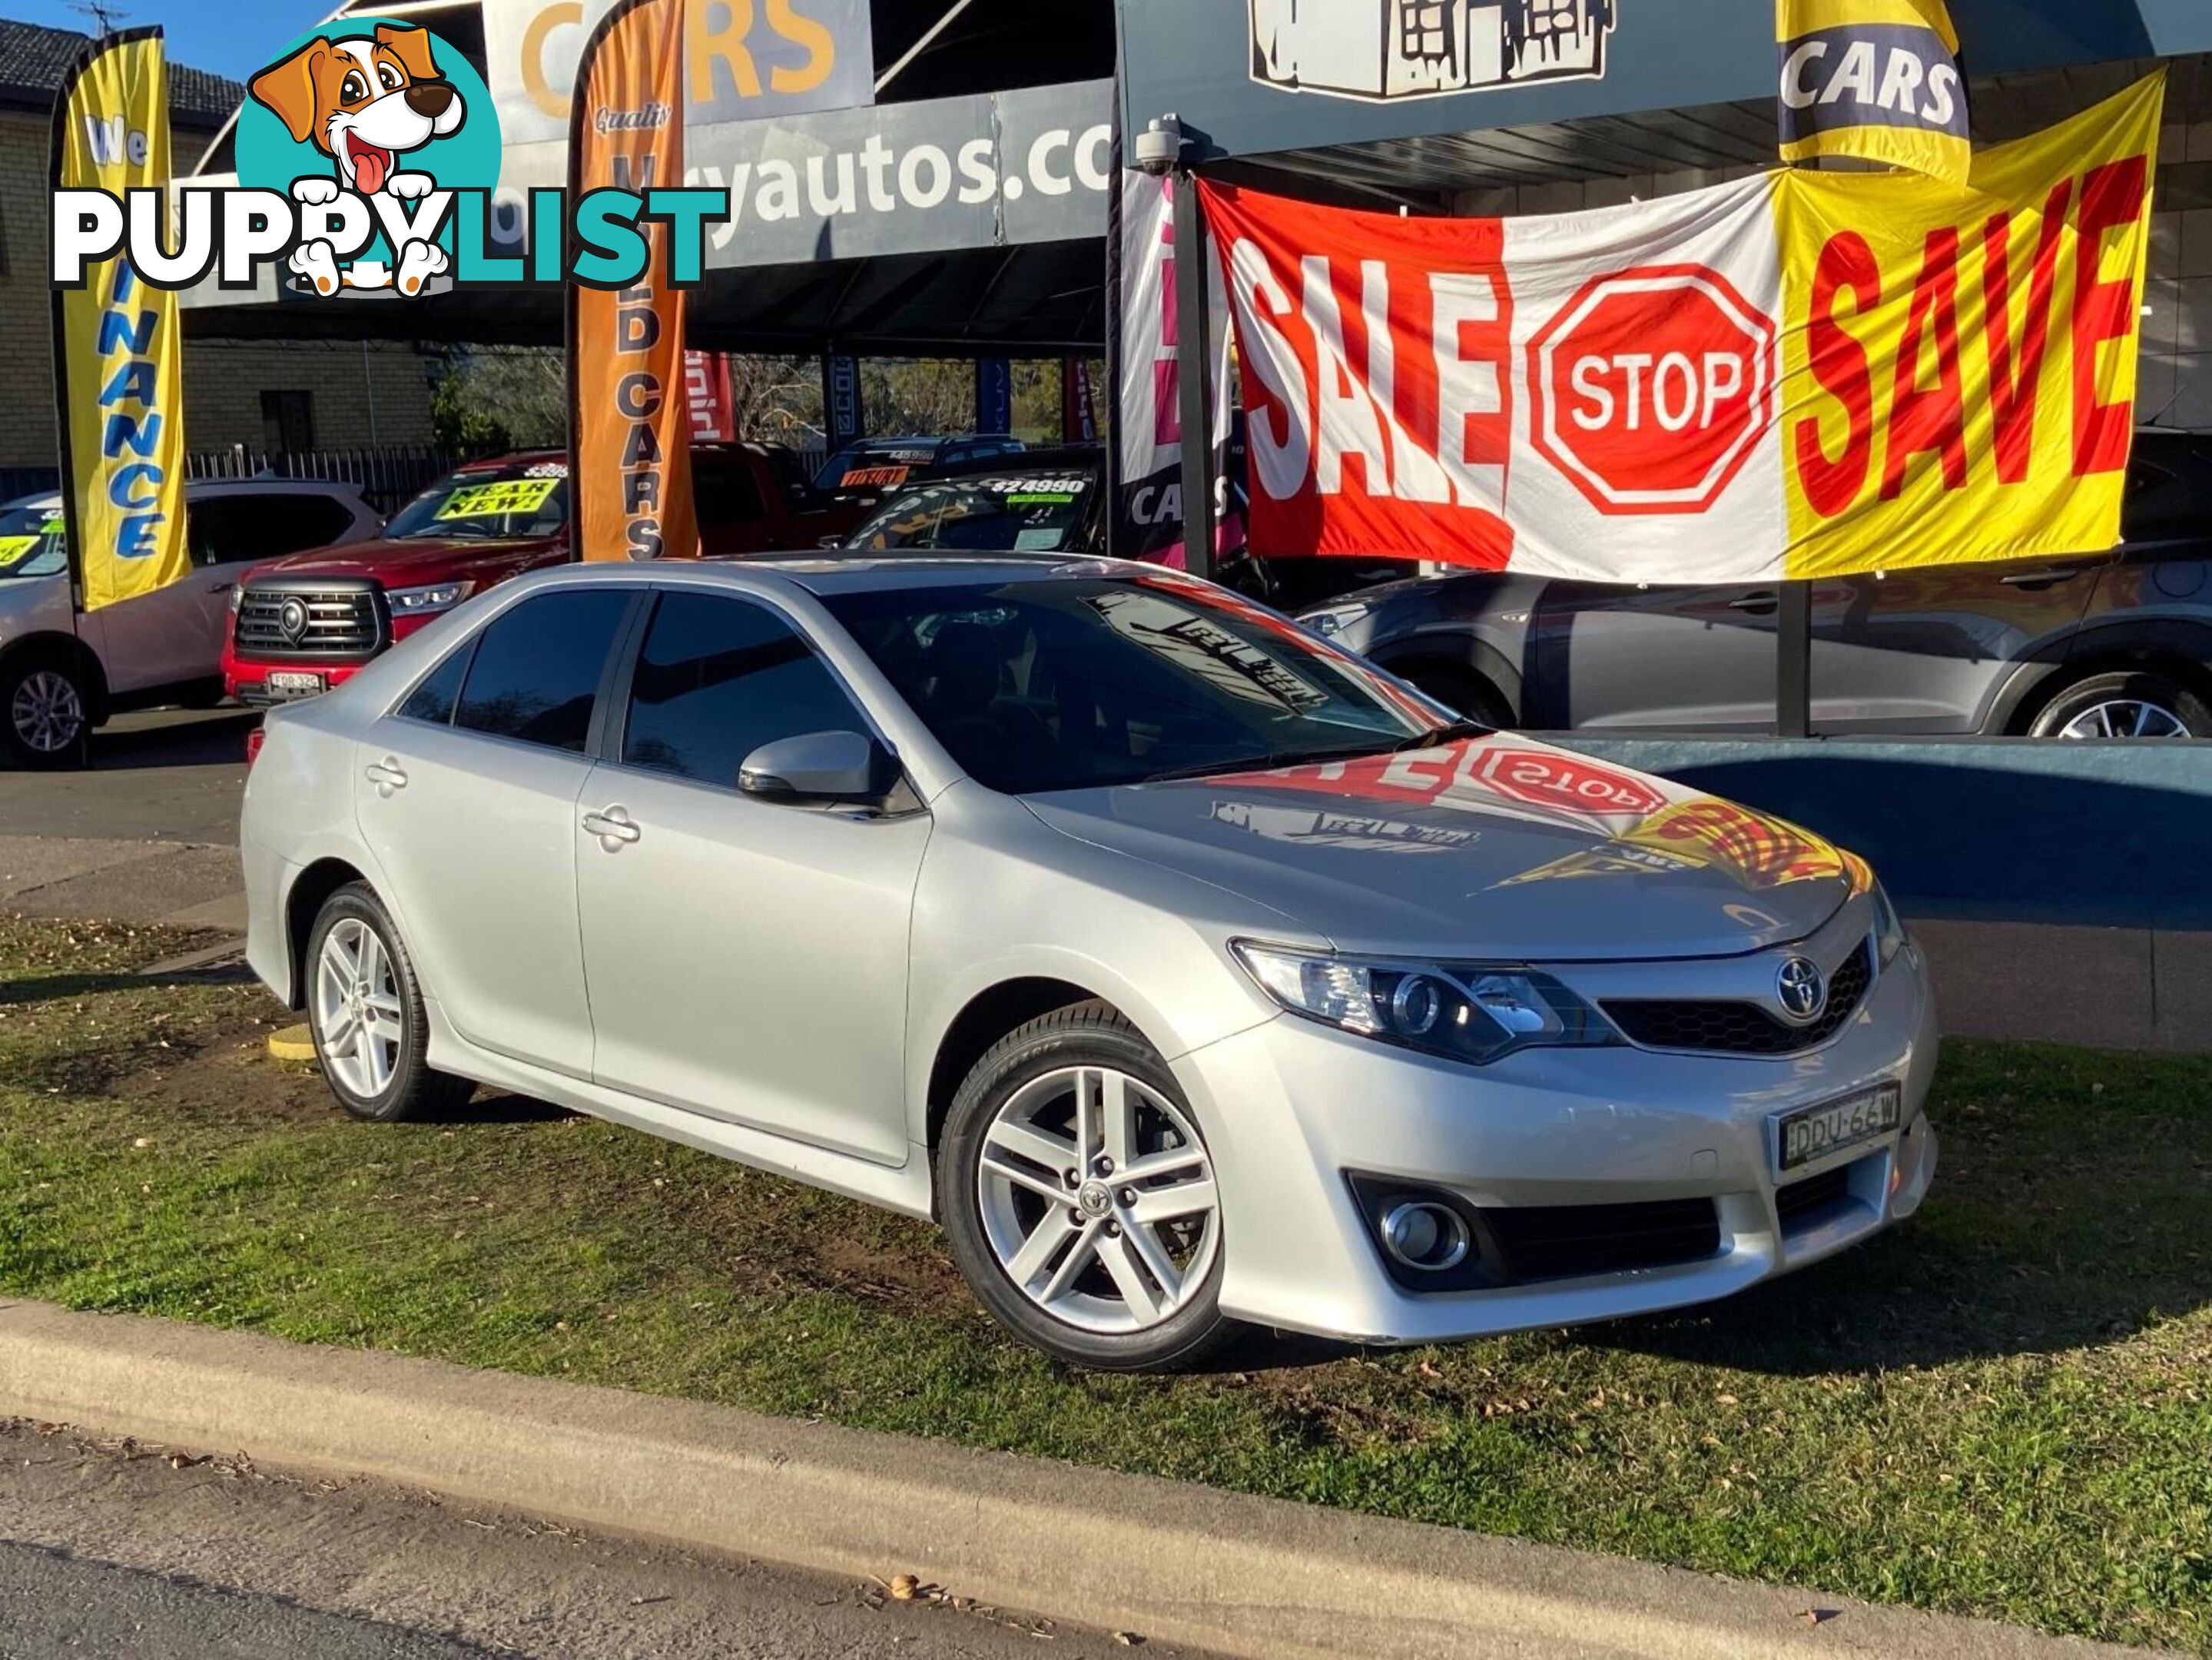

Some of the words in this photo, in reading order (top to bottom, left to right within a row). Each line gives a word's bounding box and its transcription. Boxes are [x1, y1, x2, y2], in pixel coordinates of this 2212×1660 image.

[521, 0, 835, 120] CRS
[1779, 41, 1958, 125] CARS
[85, 114, 150, 168] We
[1231, 237, 1504, 518] SALE
[1570, 350, 1743, 432] STOP
[1795, 154, 2147, 519] SAVE
[98, 257, 165, 559] INANCE
[452, 482, 549, 501] NEAR
[615, 373, 665, 563] CARS
[991, 479, 1085, 493] $24990
[1131, 475, 1227, 526] CAS
[439, 495, 540, 517] NEW!
